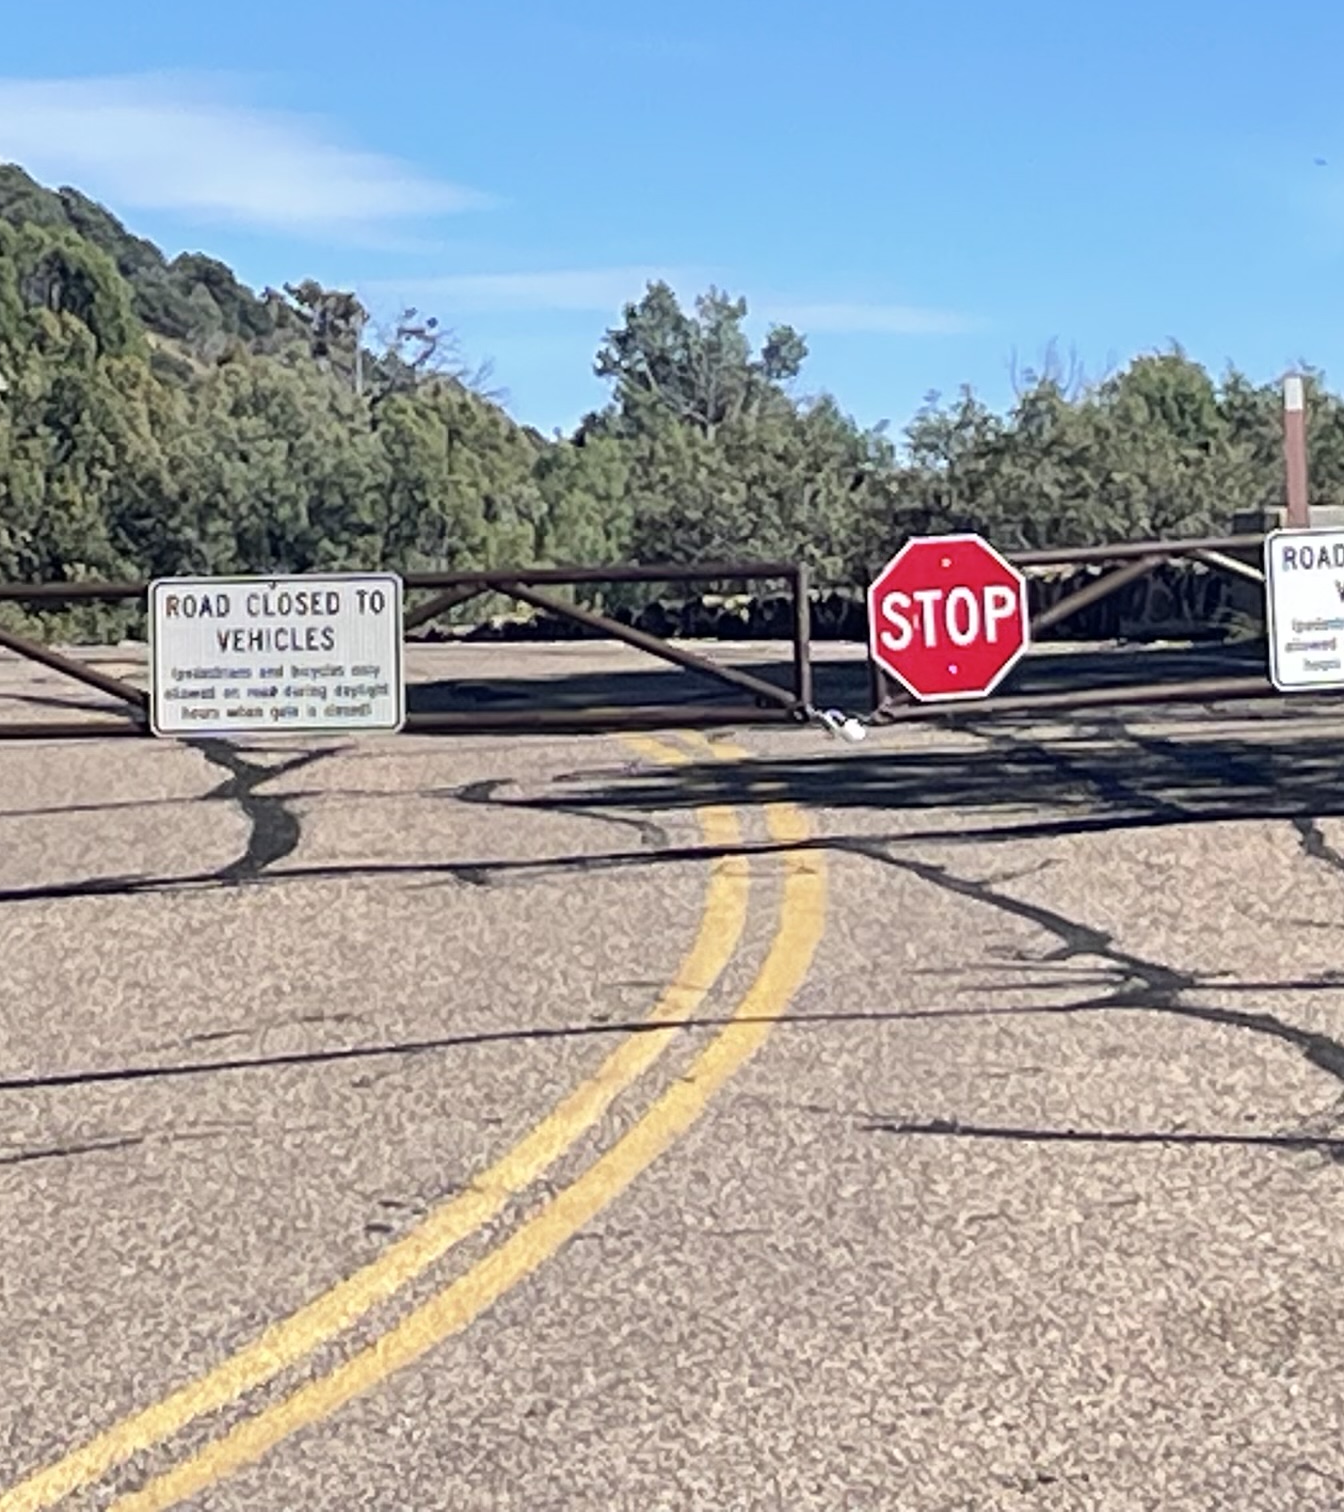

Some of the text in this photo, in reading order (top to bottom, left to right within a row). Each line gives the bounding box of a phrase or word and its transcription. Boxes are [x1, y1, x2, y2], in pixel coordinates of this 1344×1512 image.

[165, 589, 385, 618] ROAD CLOSED TO
[880, 586, 1017, 651] STOP
[216, 626, 336, 652] VEHICLES
